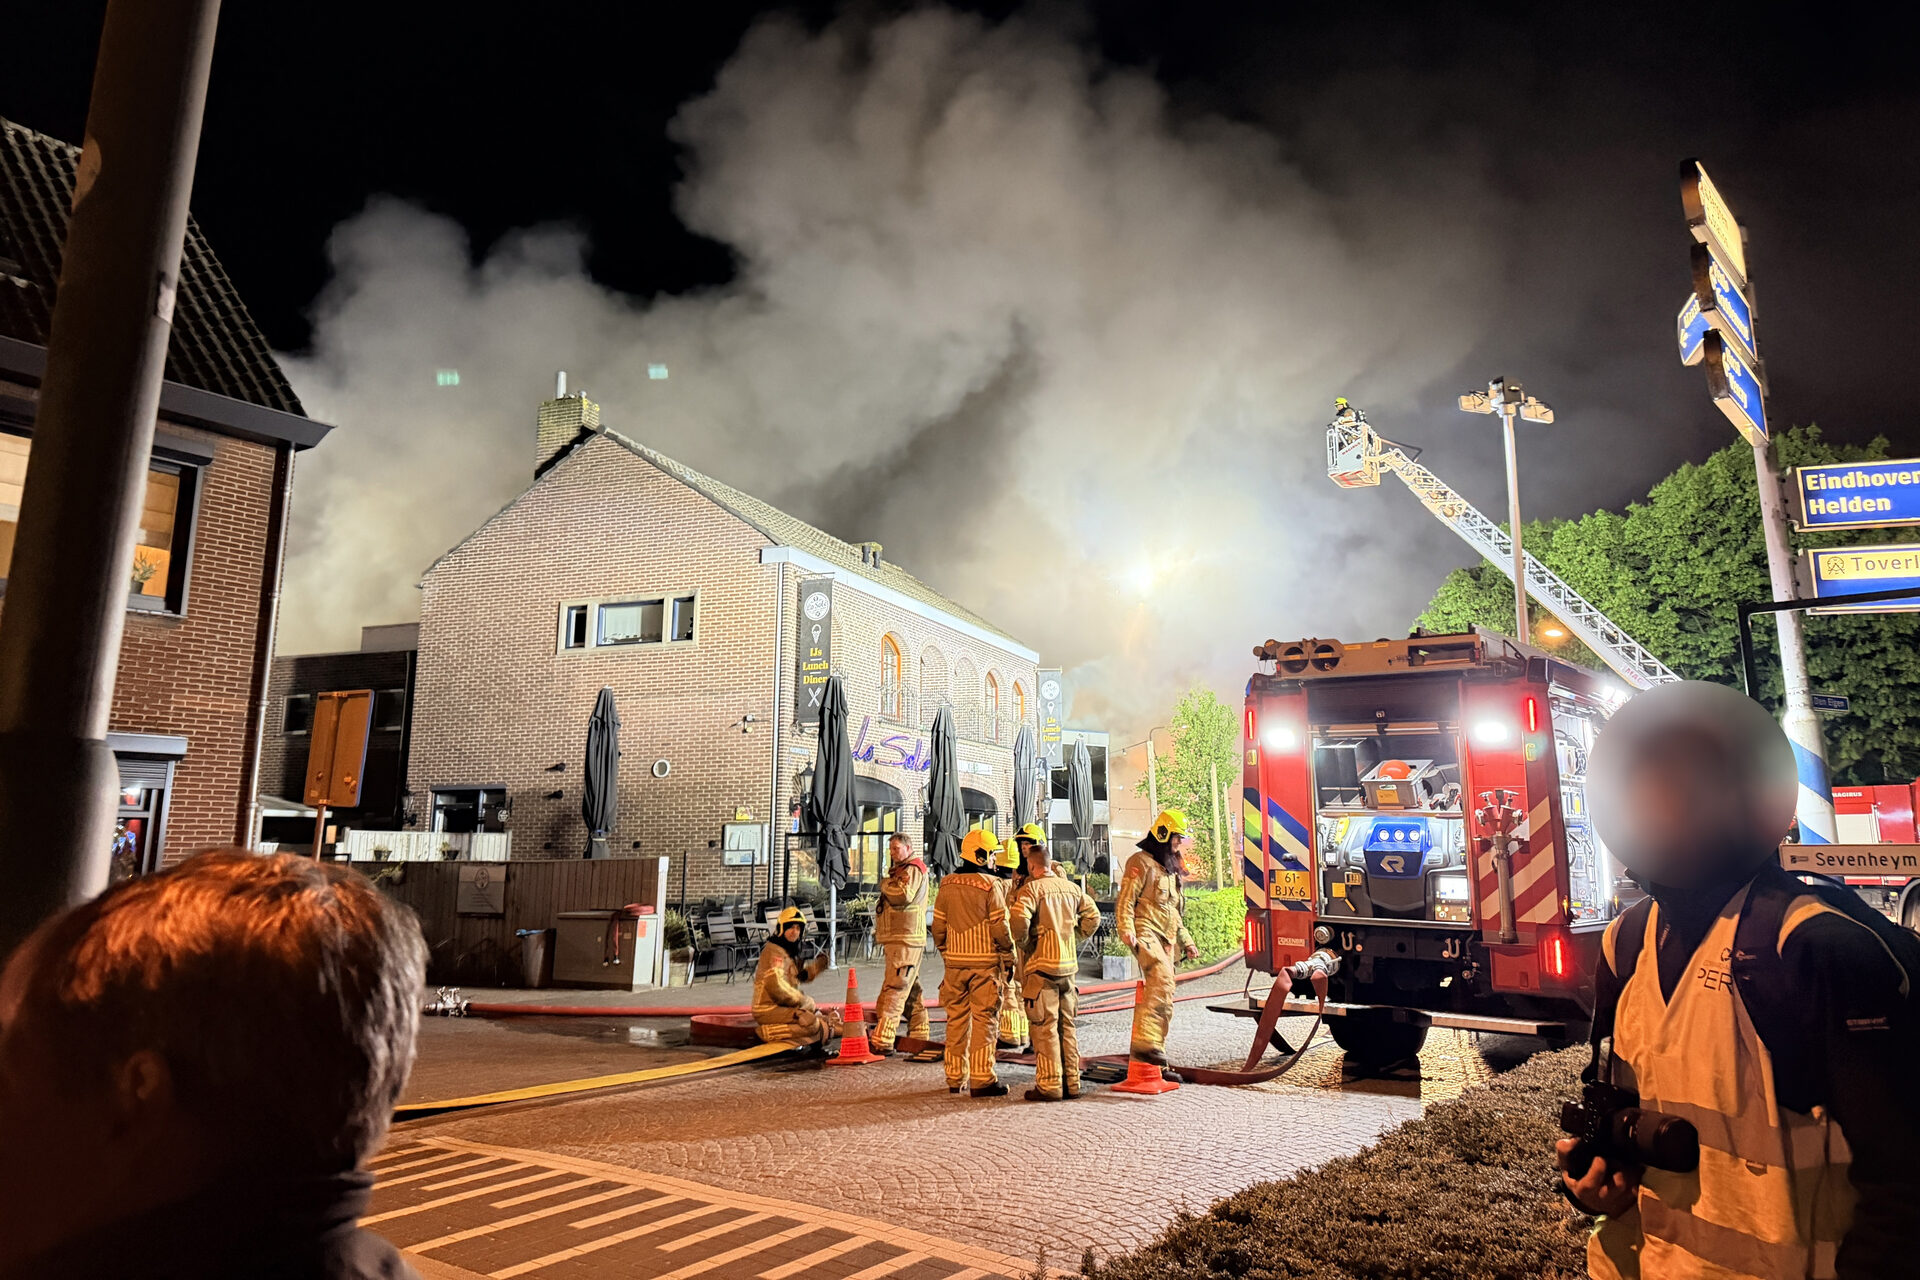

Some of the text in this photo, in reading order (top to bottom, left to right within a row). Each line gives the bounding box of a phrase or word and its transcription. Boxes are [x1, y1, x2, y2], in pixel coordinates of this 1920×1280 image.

[1809, 496, 1891, 515] Helden
[1850, 554, 1919, 571] Toverl
[803, 661, 828, 671] Lunch
[803, 675, 828, 684] Diner
[852, 715, 875, 762] La
[1815, 852, 1917, 869] Sevenheym
[1284, 873, 1300, 884] 61-
[1275, 885, 1306, 897] BJX-6
